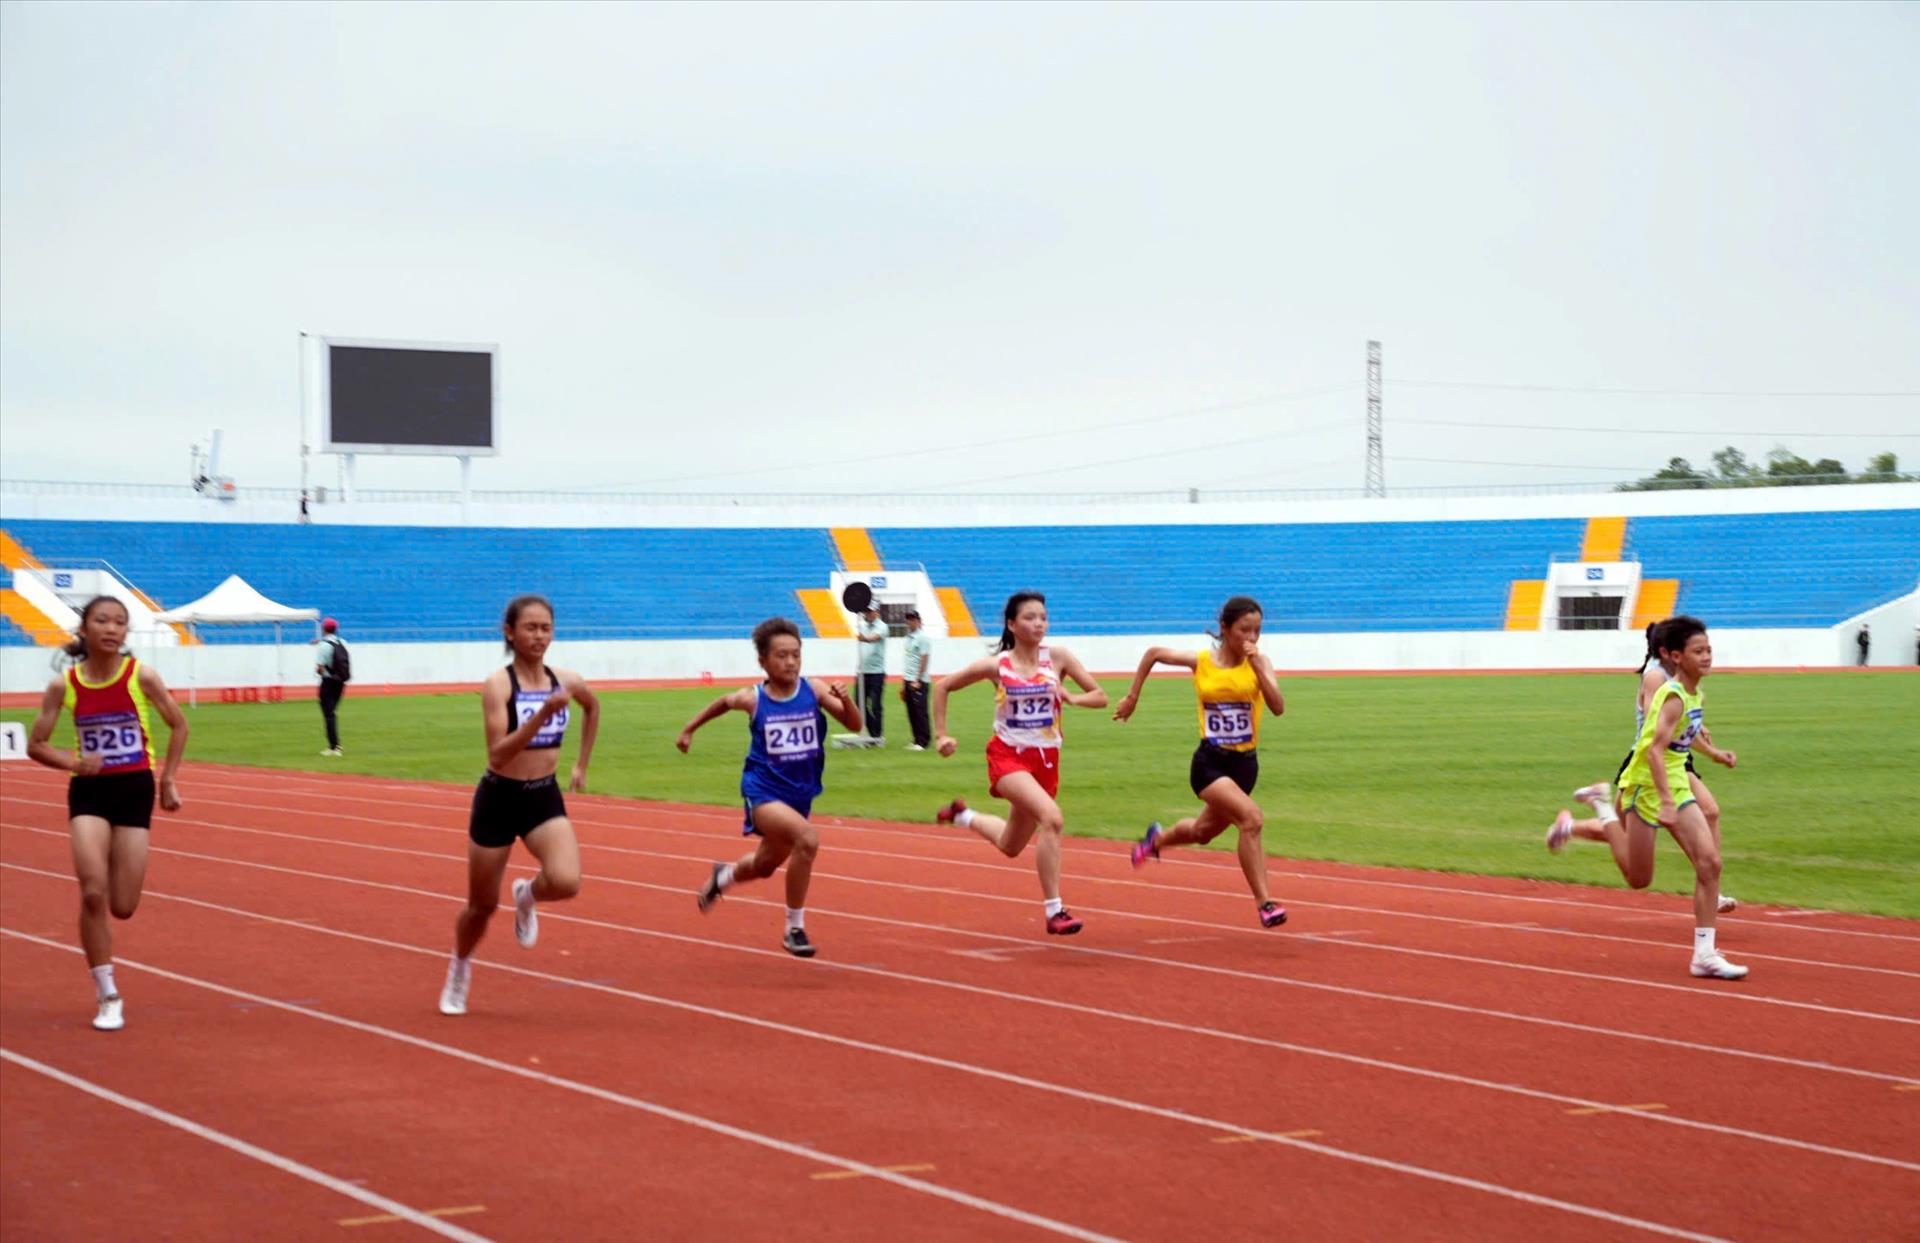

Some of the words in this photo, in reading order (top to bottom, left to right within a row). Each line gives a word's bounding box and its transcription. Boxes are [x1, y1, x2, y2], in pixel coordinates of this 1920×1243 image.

[1009, 697, 1050, 715] 132
[1208, 713, 1249, 732] 655
[6, 730, 15, 751] 1
[83, 726, 136, 752] 526
[769, 725, 815, 748] 240
